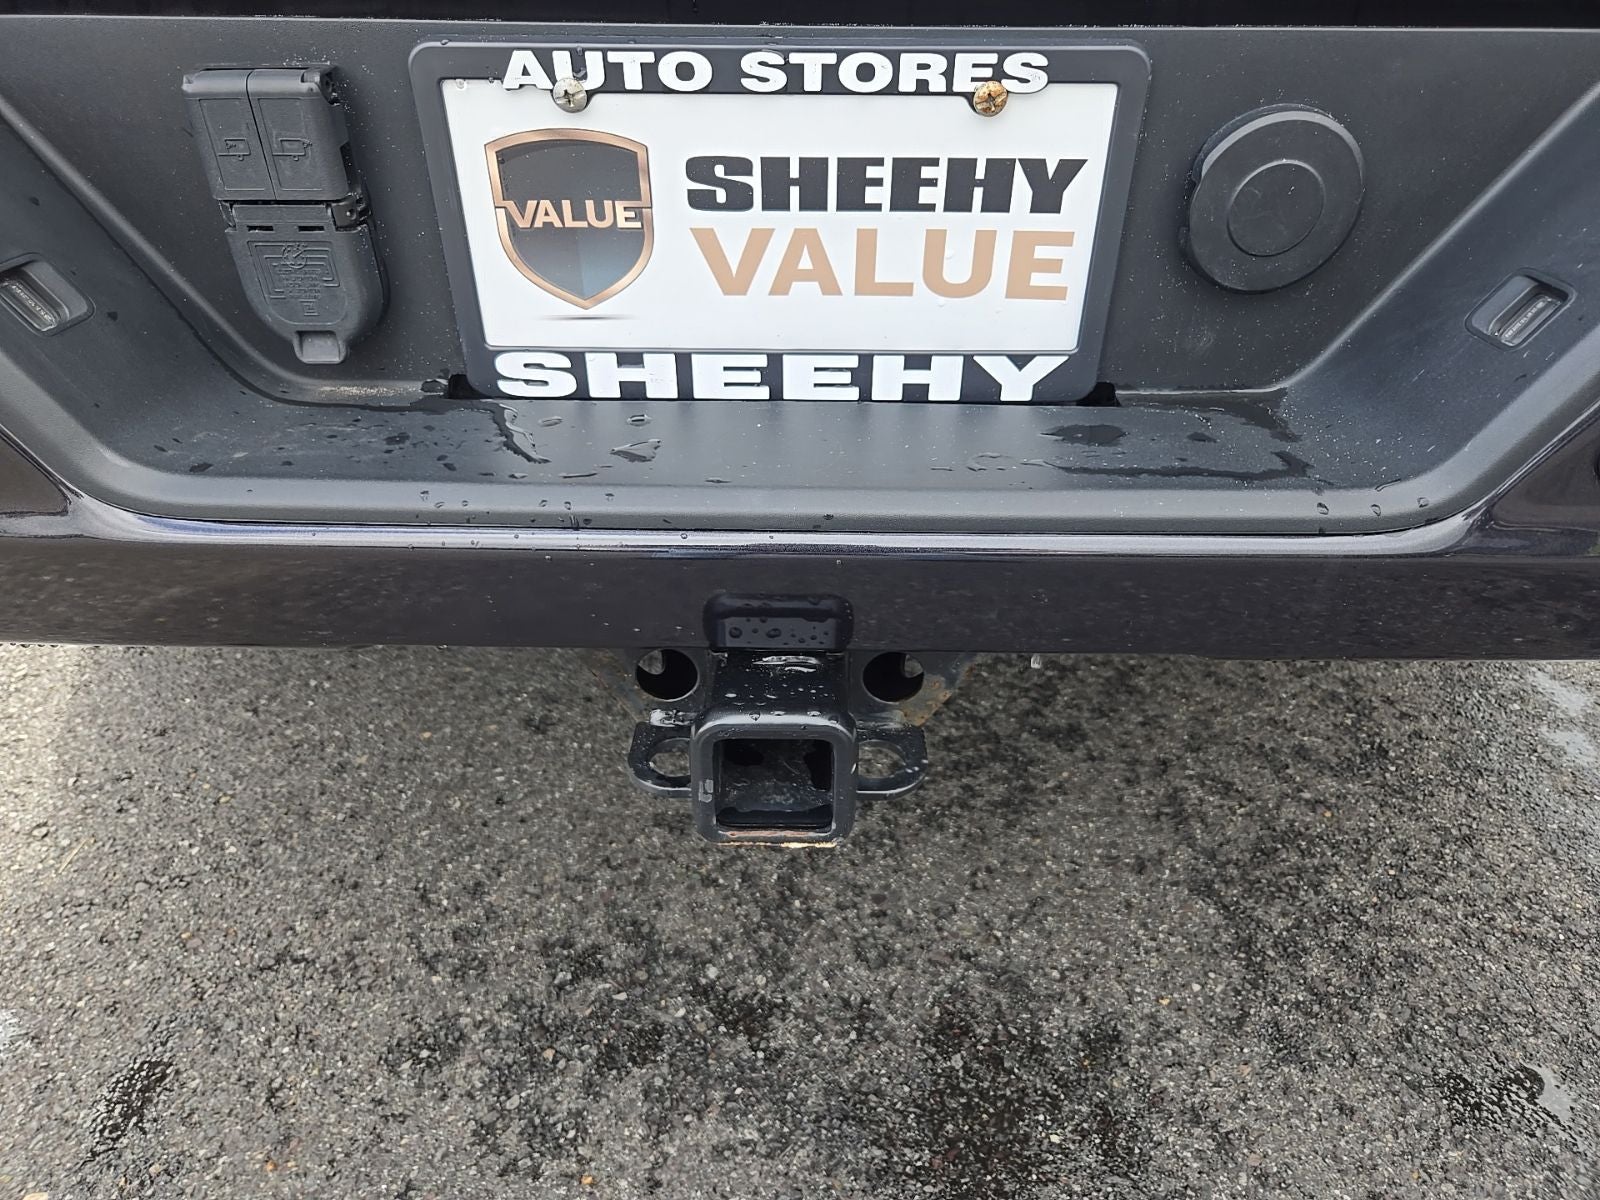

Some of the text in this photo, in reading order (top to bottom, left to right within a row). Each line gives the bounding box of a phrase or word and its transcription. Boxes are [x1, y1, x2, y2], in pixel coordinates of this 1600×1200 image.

[503, 50, 1049, 93] AUTO STORES
[686, 157, 1088, 213] SHEEHY
[509, 199, 642, 229] VALUE
[691, 228, 1076, 300] VALUE
[495, 352, 1069, 401] SHEEHY
